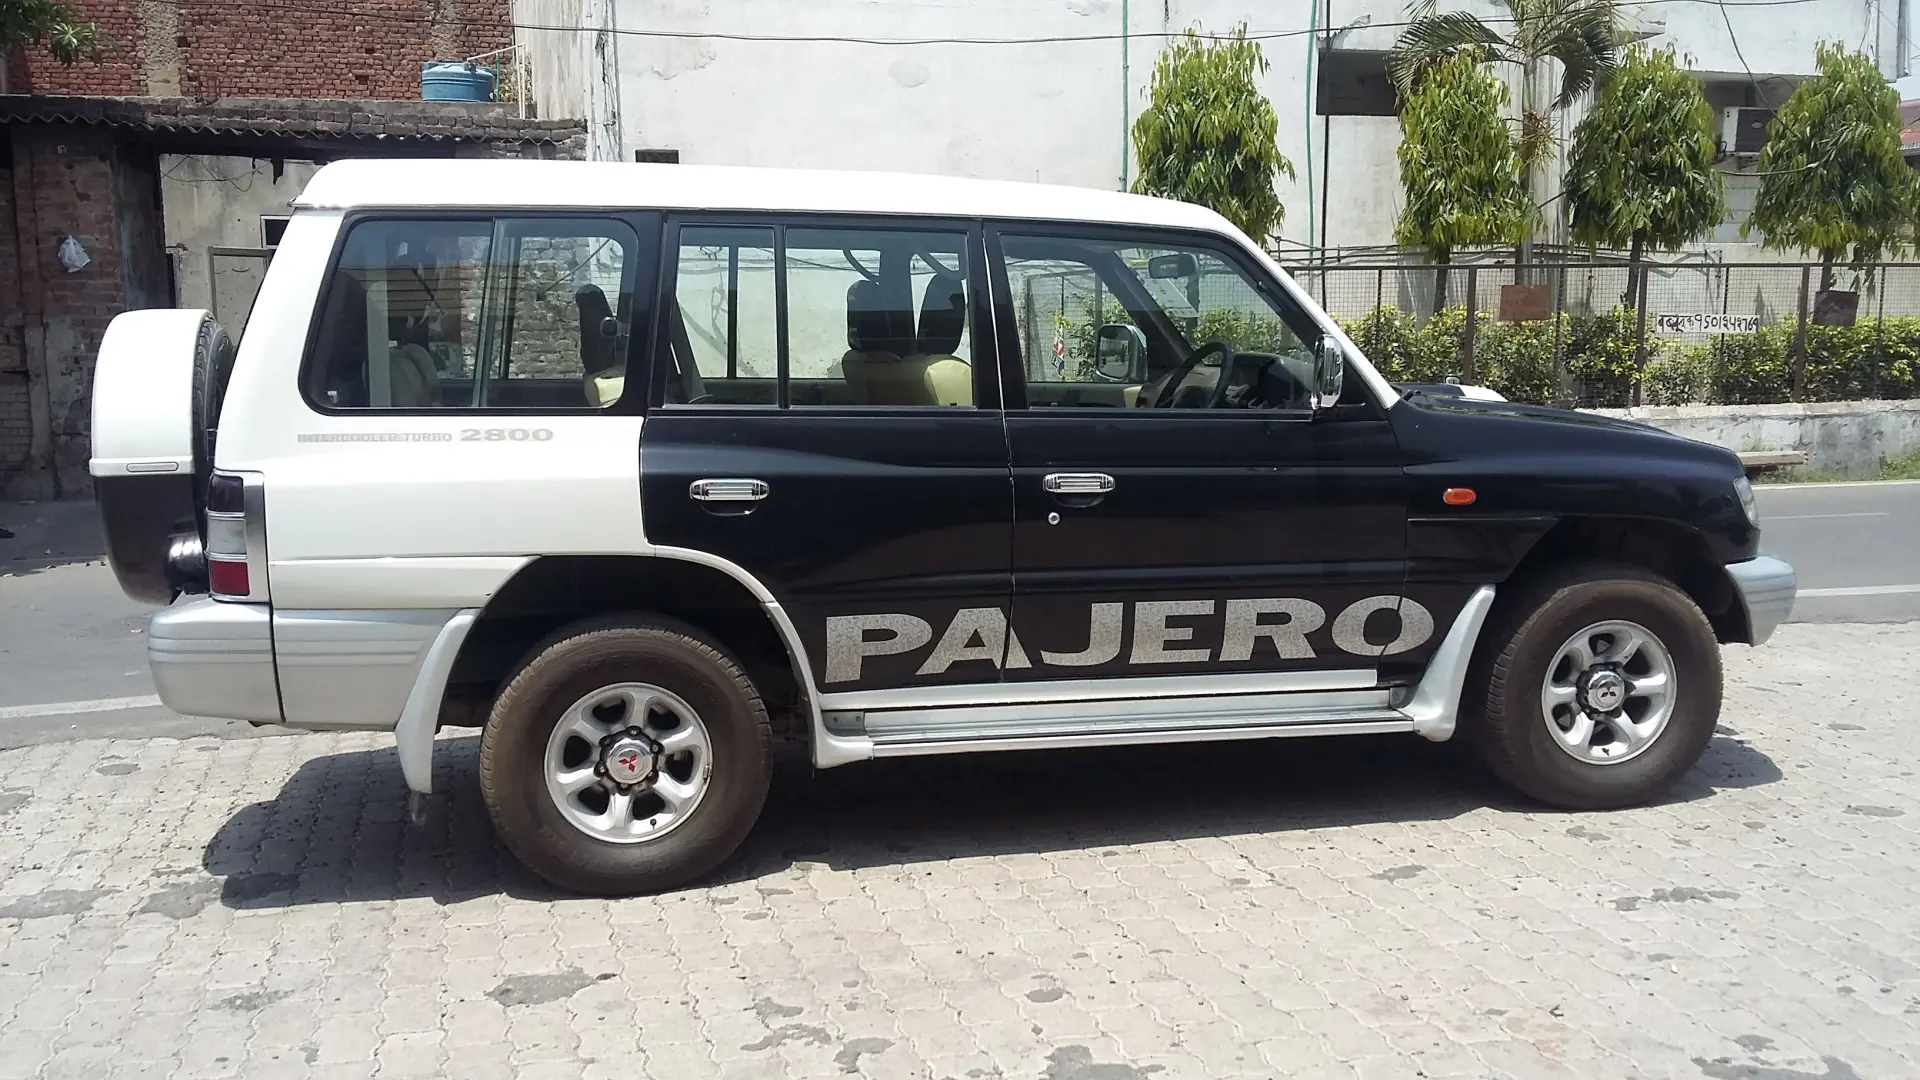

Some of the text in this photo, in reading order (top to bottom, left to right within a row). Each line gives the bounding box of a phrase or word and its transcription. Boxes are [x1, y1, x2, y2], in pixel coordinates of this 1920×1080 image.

[403, 432, 453, 442] TURBO
[460, 428, 555, 442] 2800
[824, 595, 1435, 684] PAJERO
